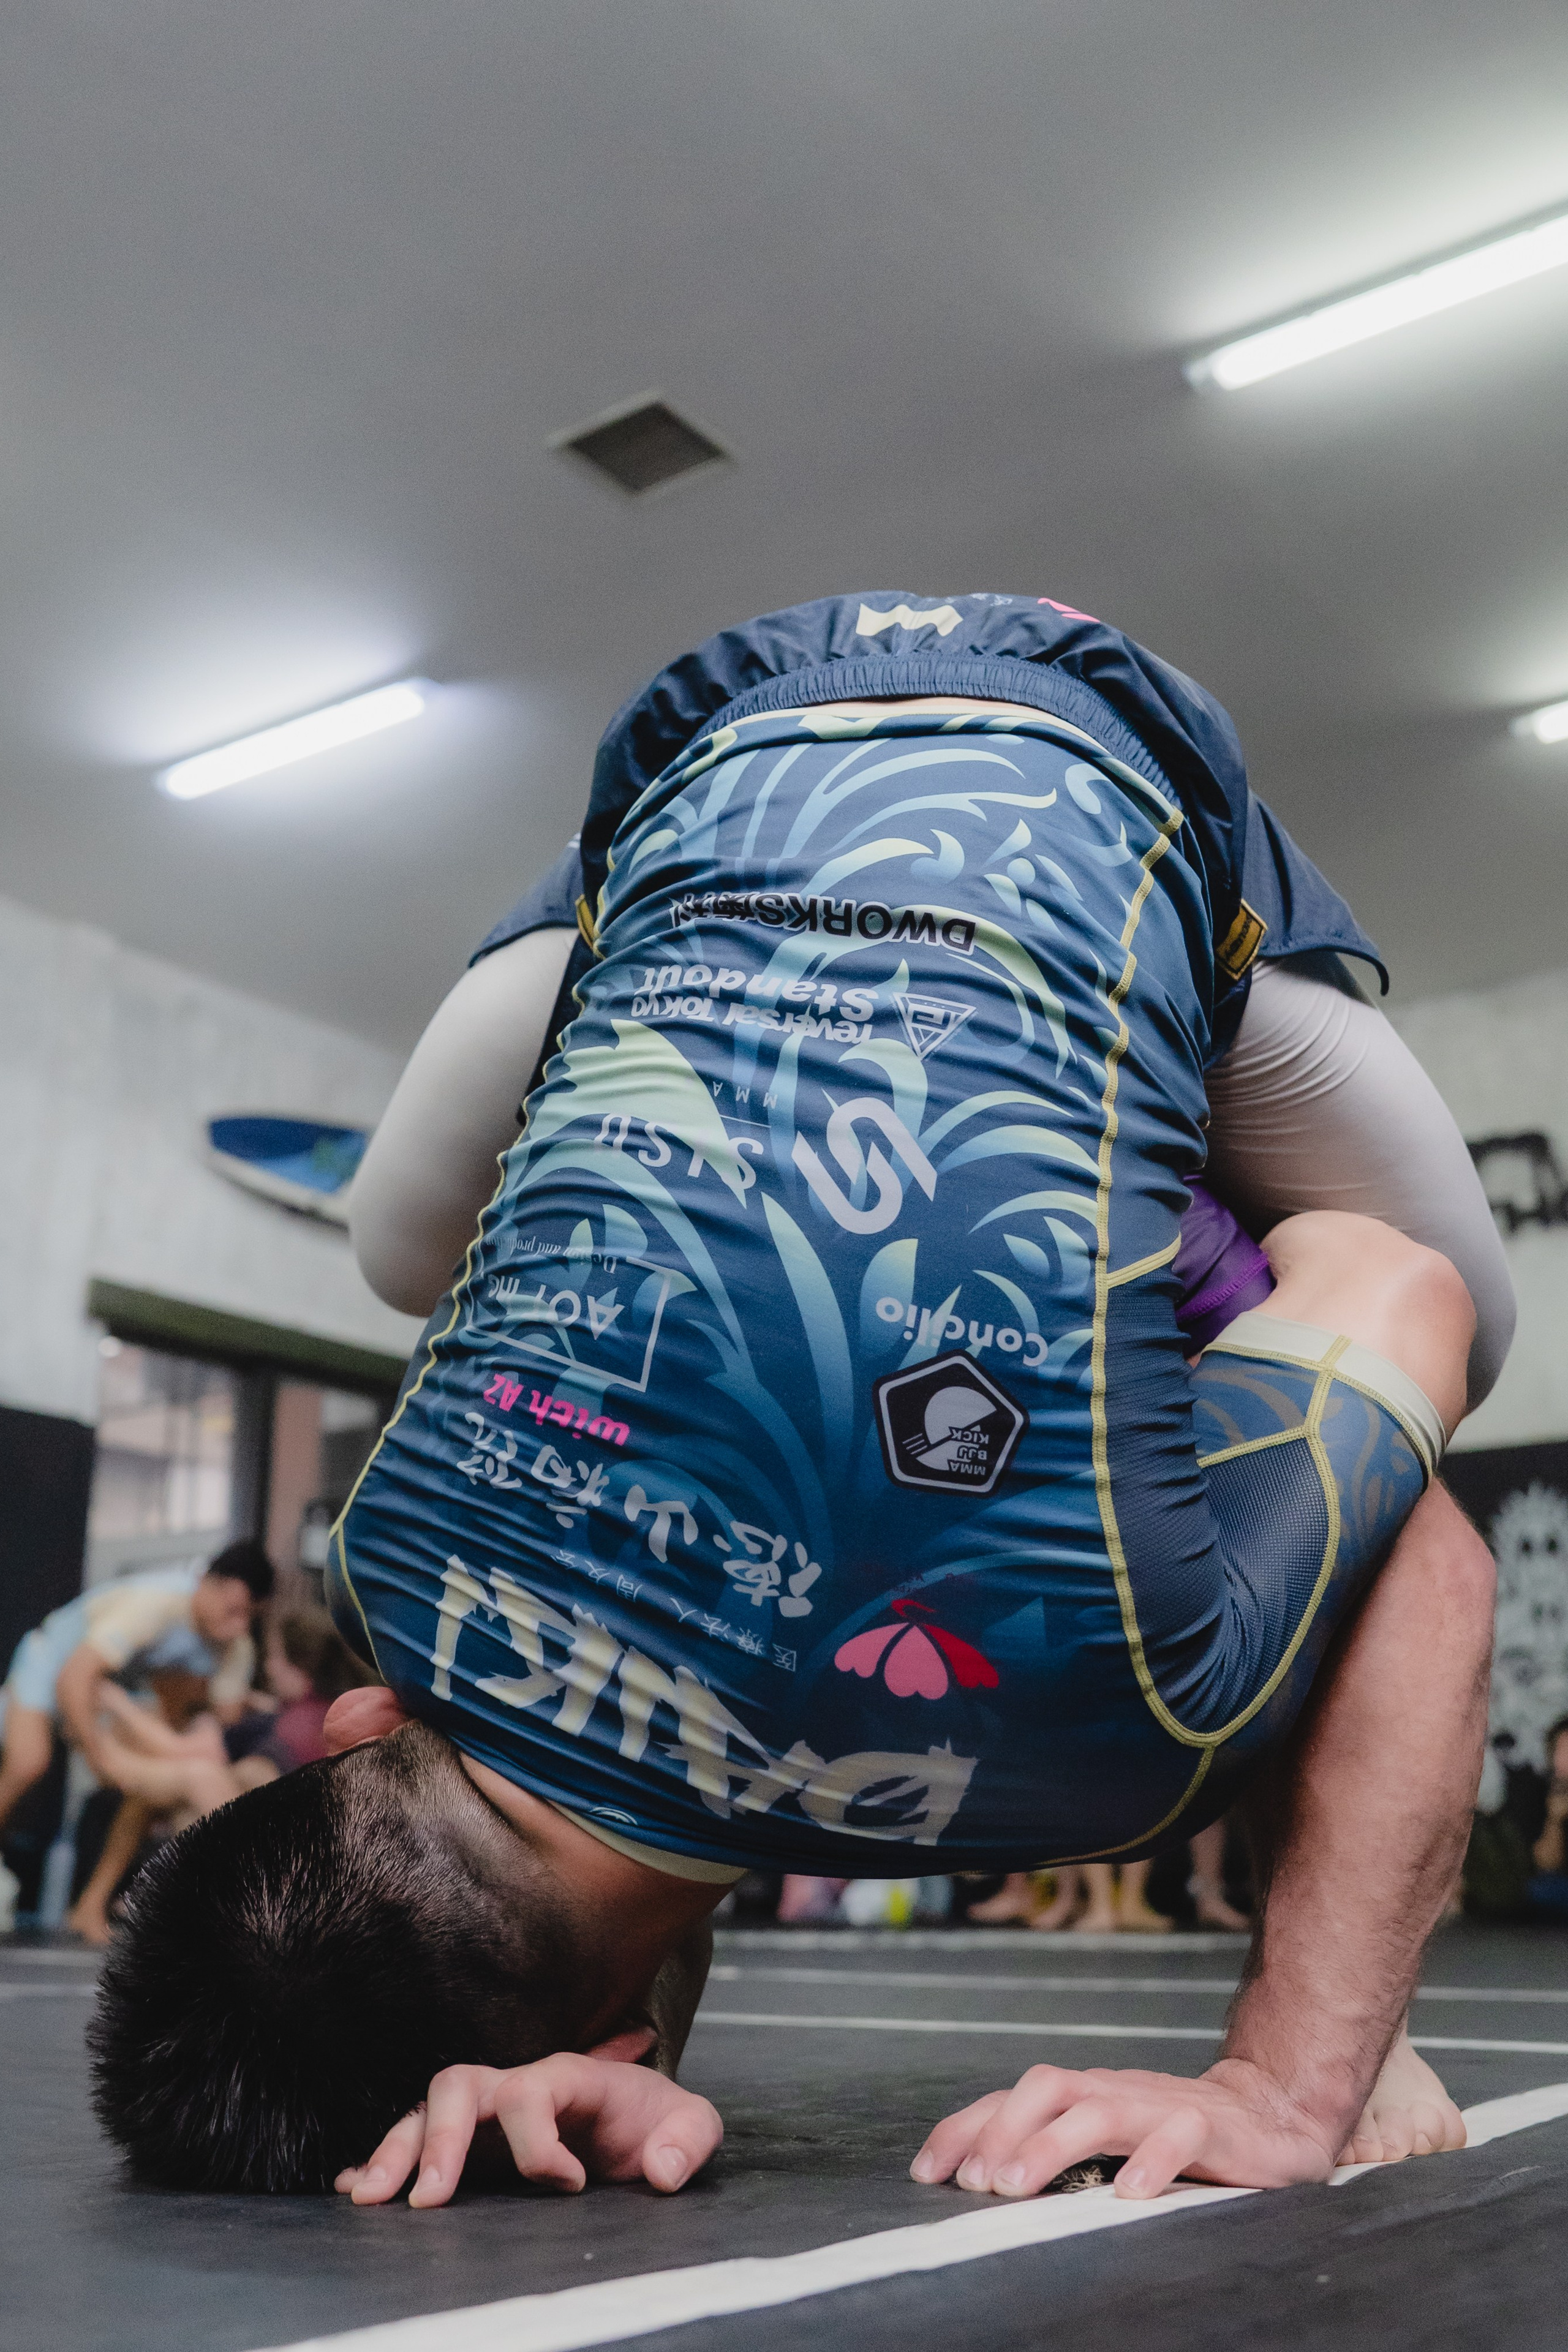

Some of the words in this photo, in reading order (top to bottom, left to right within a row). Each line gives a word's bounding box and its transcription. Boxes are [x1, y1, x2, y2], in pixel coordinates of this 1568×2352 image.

[635, 964, 878, 1022] Standout
[724, 994, 873, 1044] reversal
[712, 1080, 778, 1109] MMA
[593, 1112, 764, 1190] SISU
[563, 1246, 617, 1275] Dein
[875, 1297, 1049, 1366] Concilio
[529, 1389, 631, 1447] with
[950, 1428, 990, 1445] KICK
[949, 1461, 986, 1476] MMA
[957, 1444, 987, 1460] BJJ
[457, 1412, 823, 1618] 徳山病院
[430, 1553, 979, 1845] DAIKI
